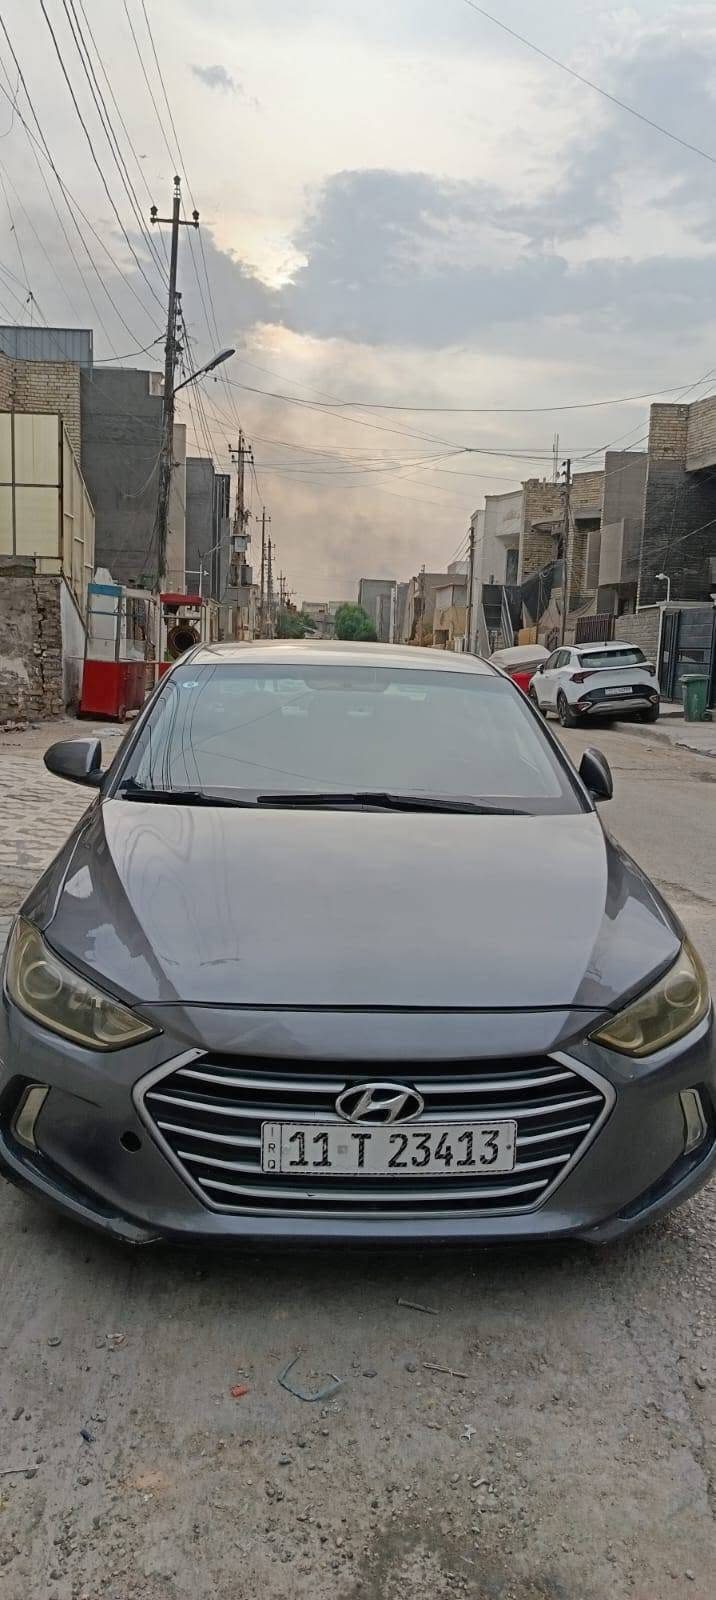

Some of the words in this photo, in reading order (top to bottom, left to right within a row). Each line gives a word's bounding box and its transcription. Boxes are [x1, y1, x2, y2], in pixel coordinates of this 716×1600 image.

[289, 1131, 332, 1167] 11
[351, 1133, 372, 1168] T
[388, 1130, 500, 1168] 23413
